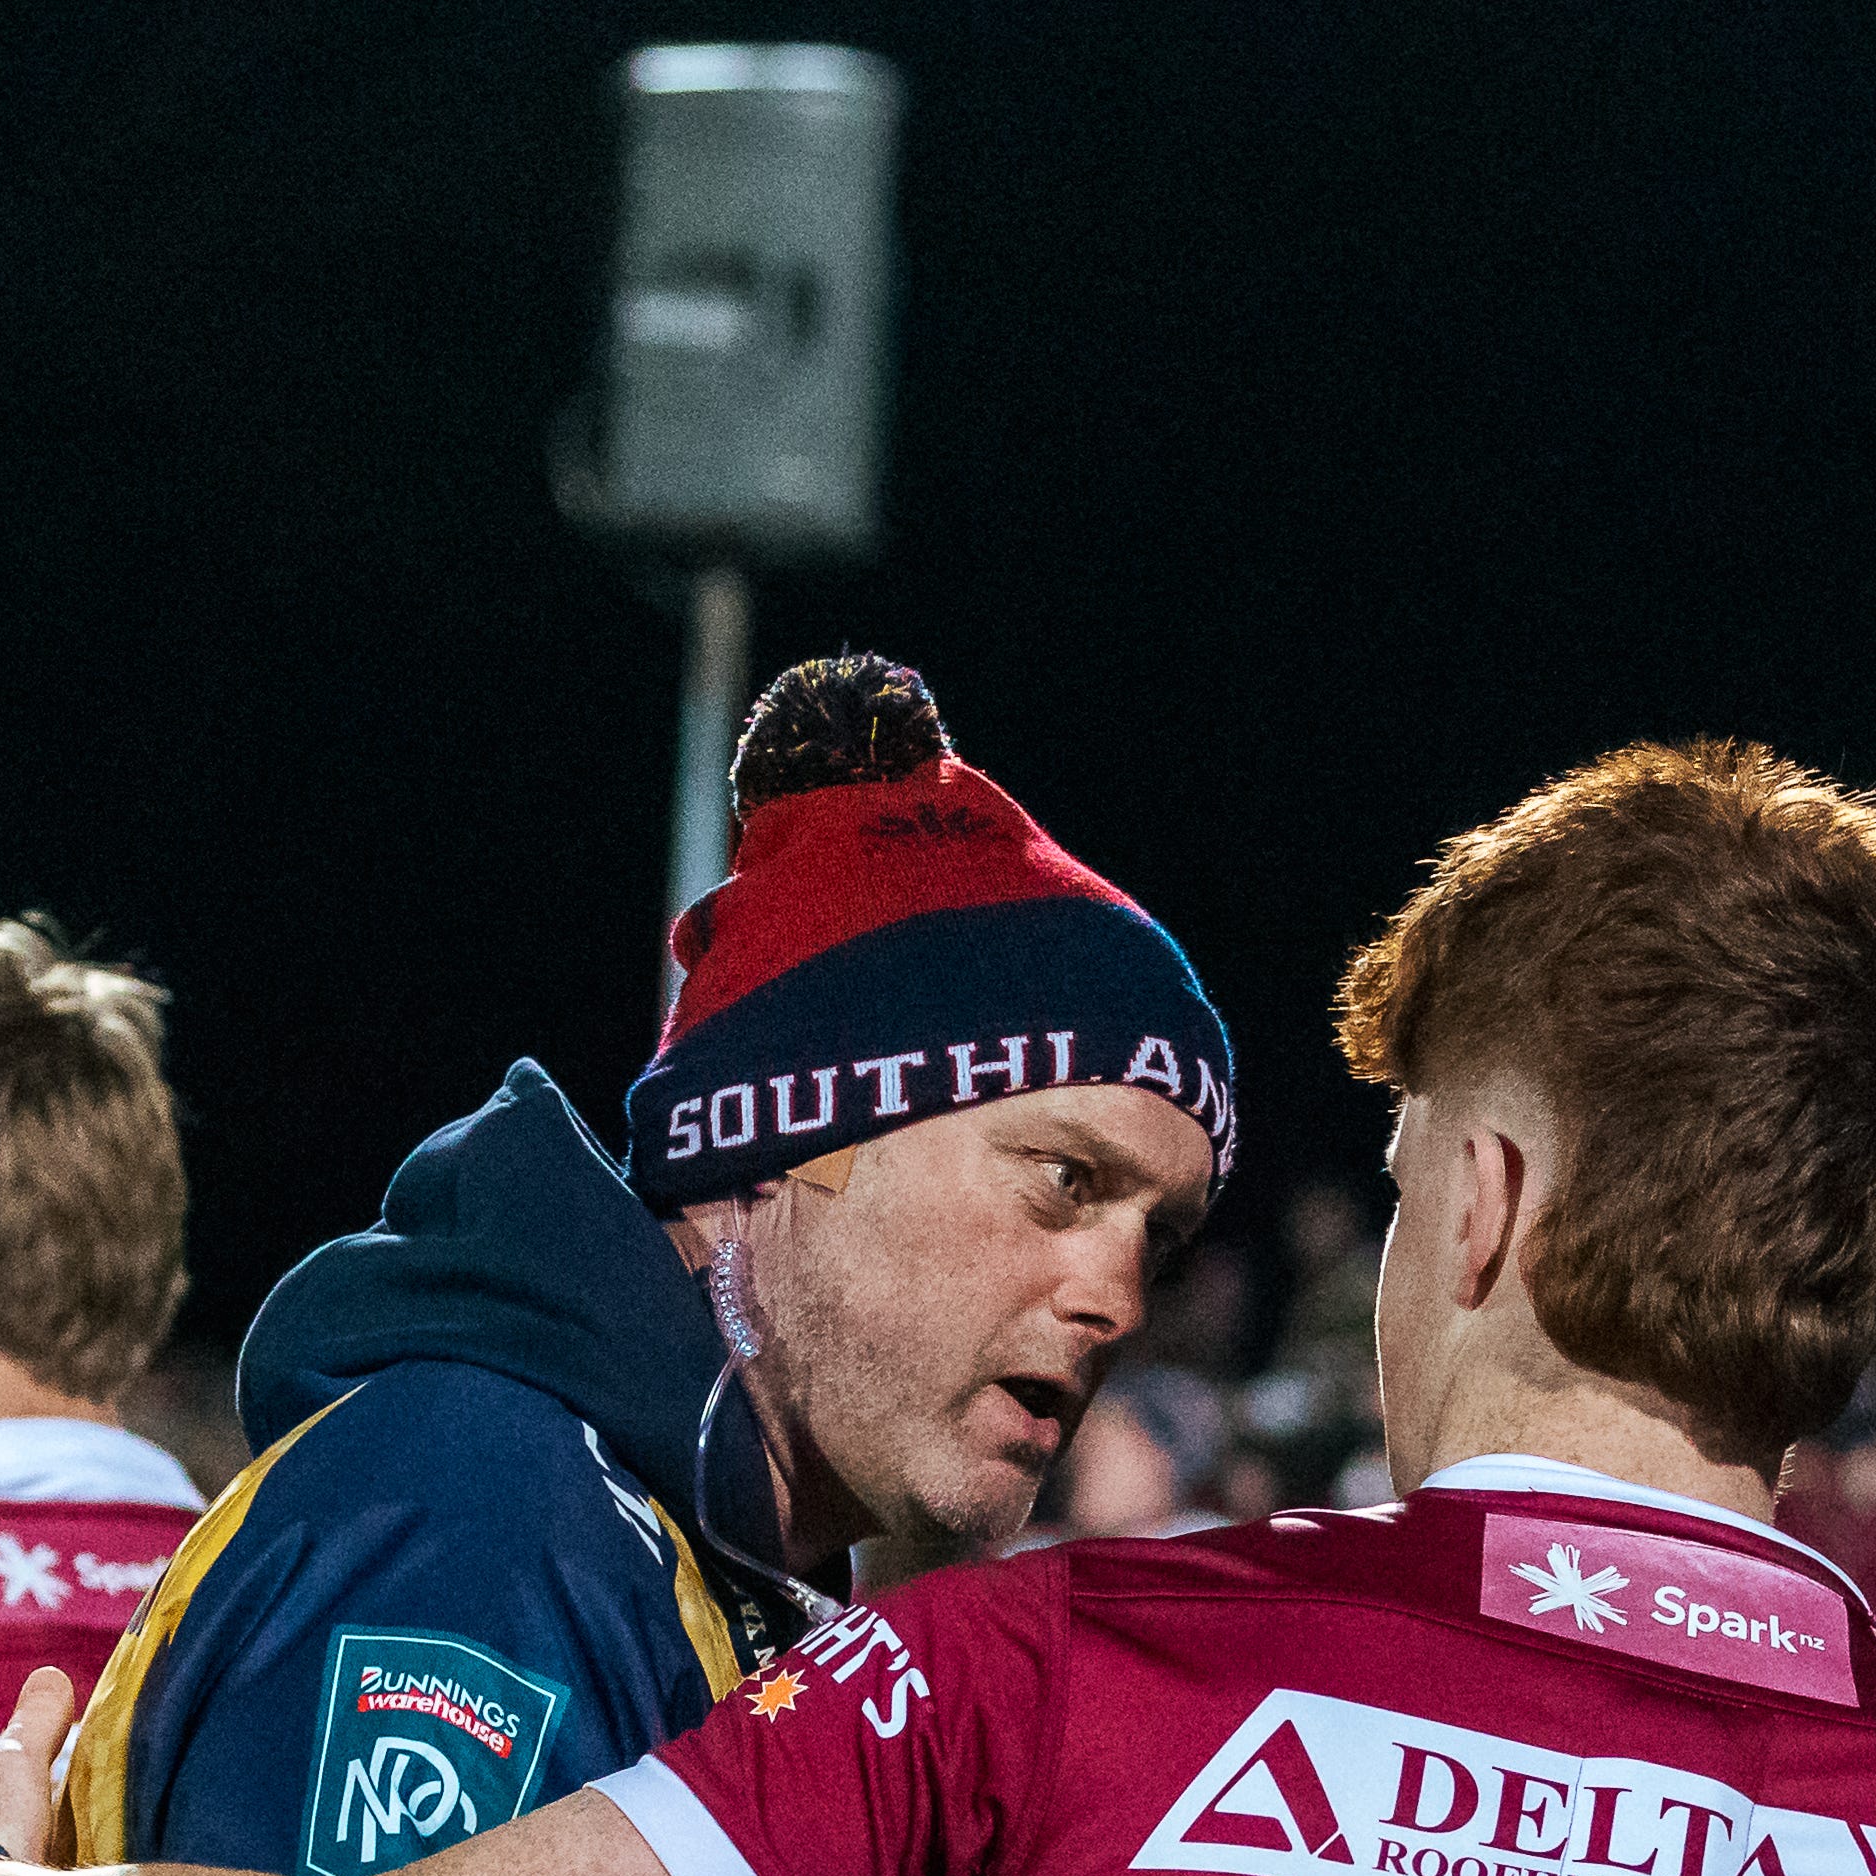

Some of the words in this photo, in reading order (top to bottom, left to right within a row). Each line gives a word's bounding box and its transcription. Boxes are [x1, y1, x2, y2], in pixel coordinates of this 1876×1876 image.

[667, 1030, 1236, 1176] SOUTHLAN
[1651, 1585, 1799, 1654] Spark
[360, 1665, 521, 1739] BUNNINGS
[367, 1690, 505, 1753] warehouse
